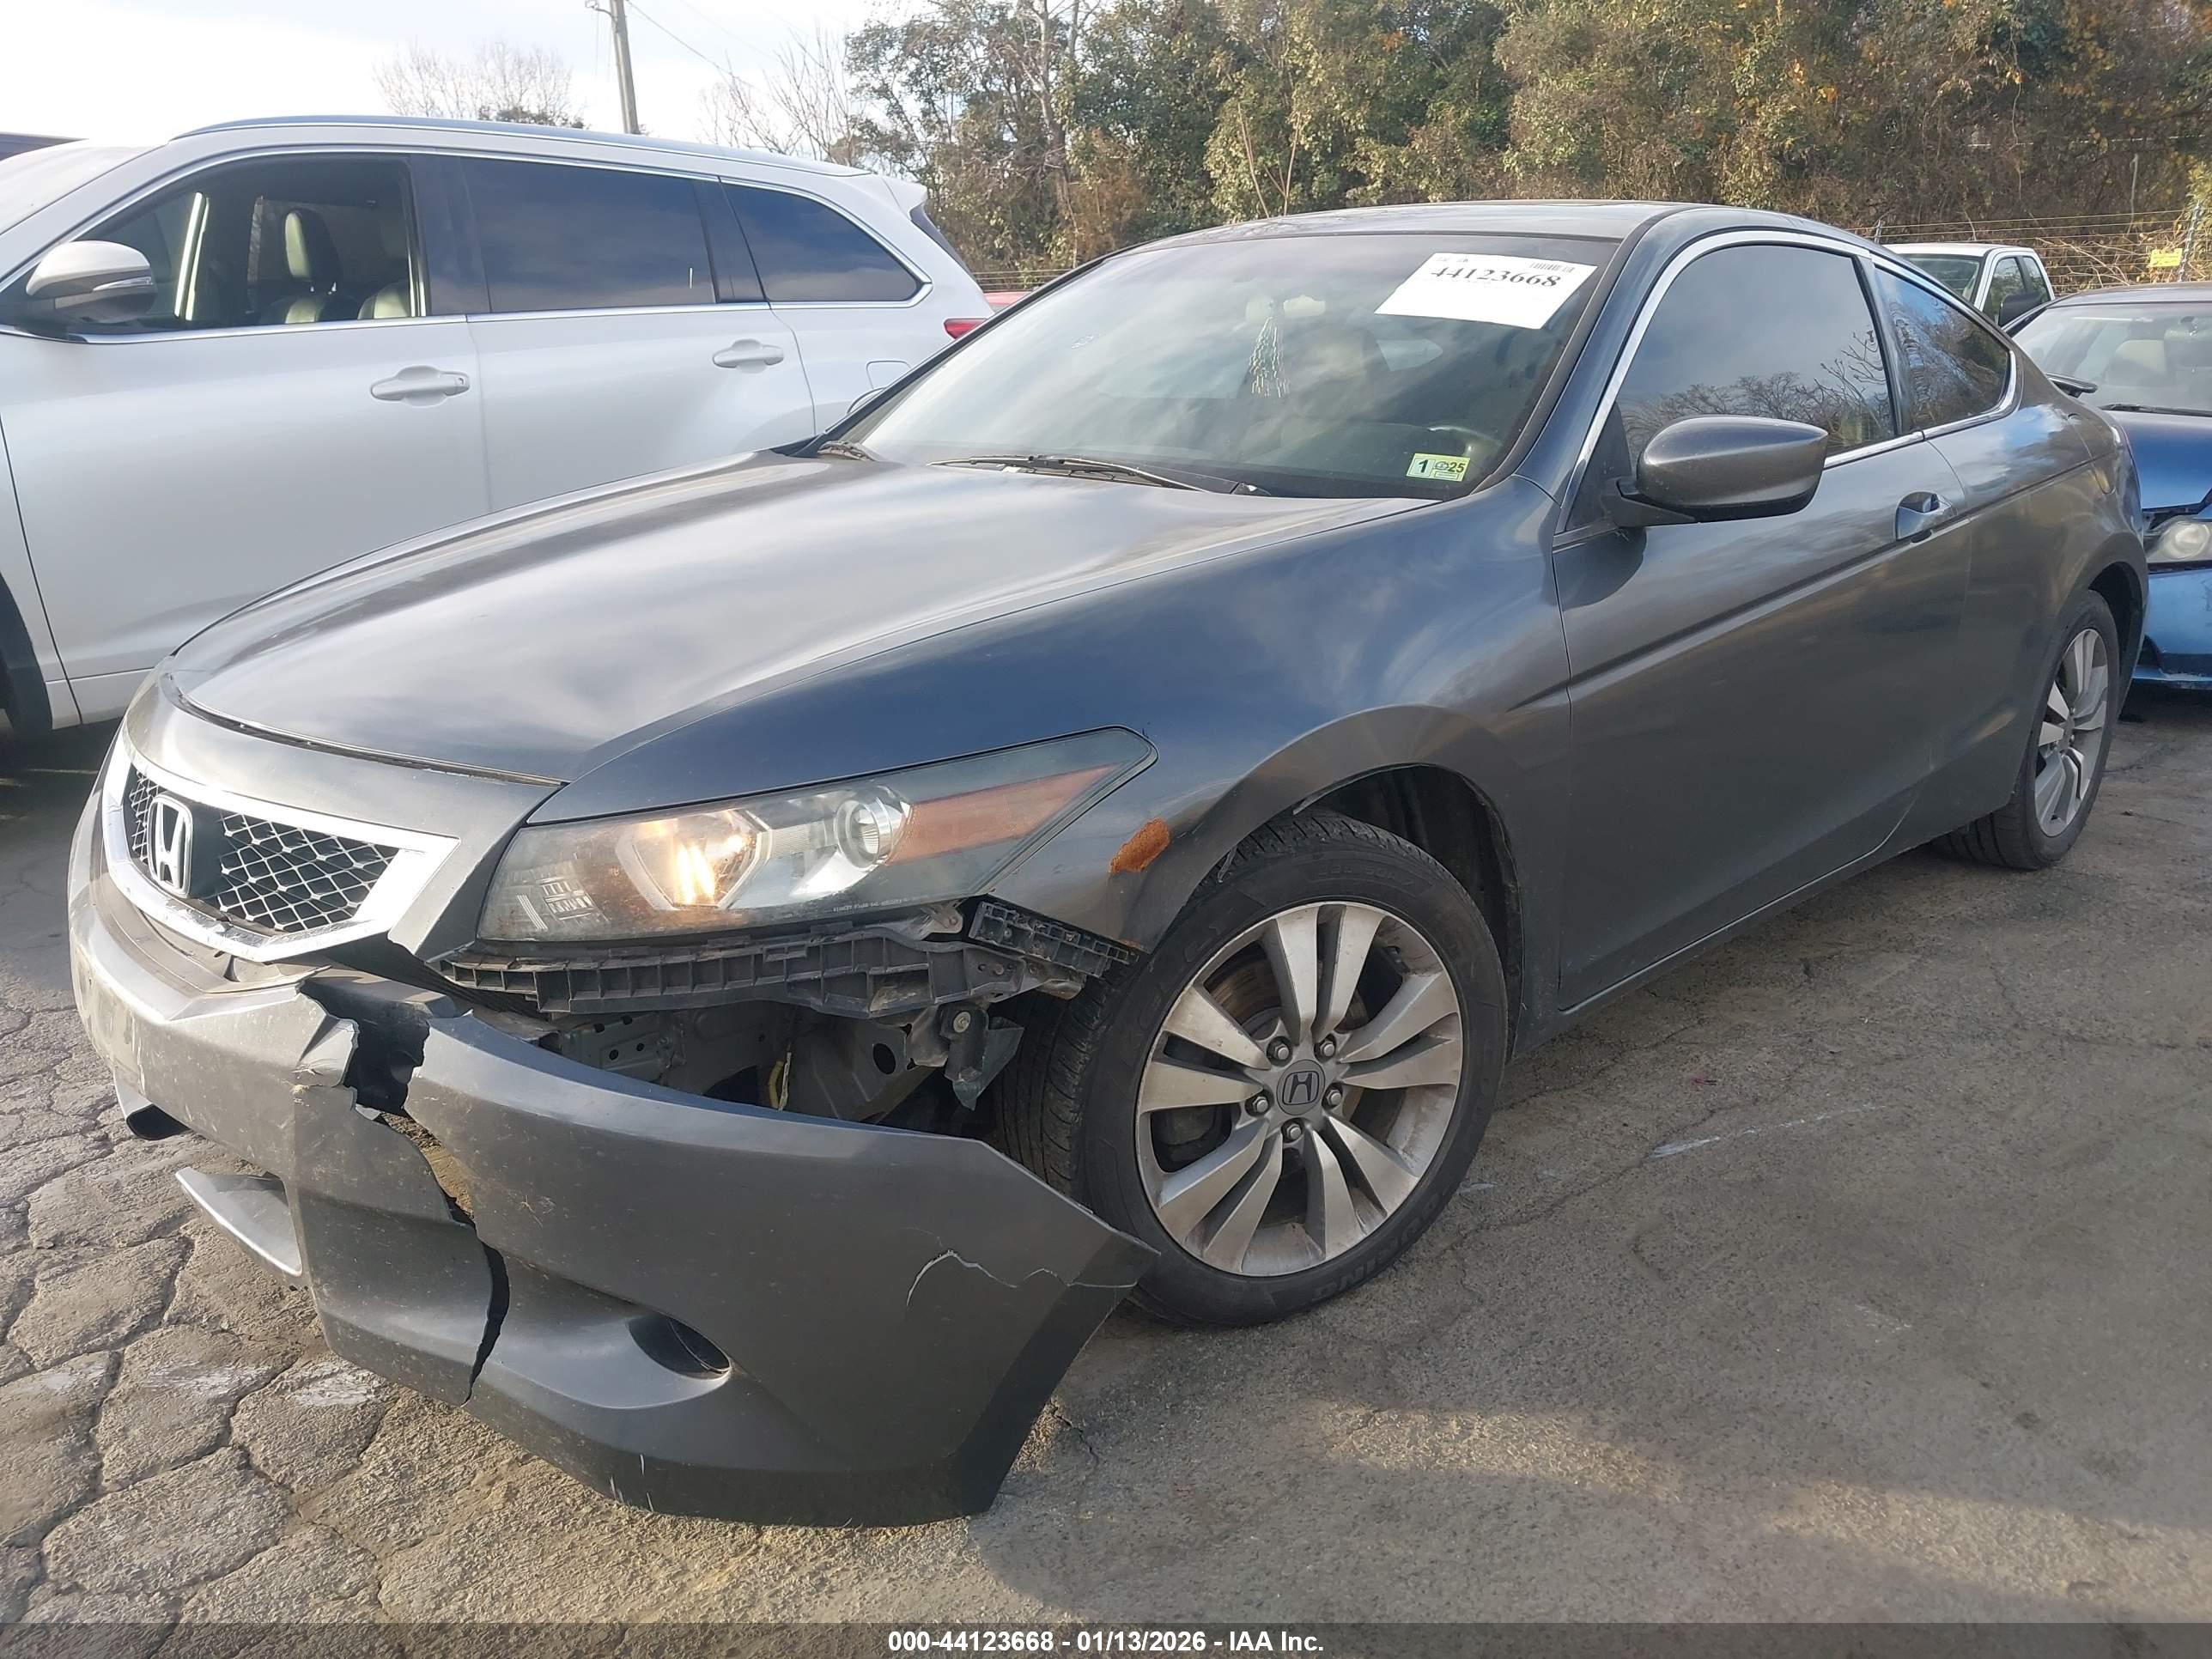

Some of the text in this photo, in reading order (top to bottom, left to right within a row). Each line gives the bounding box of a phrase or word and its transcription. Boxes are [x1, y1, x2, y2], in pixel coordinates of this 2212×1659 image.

[1431, 267, 1561, 287] 44123668
[1419, 459, 1465, 473] 1 25
